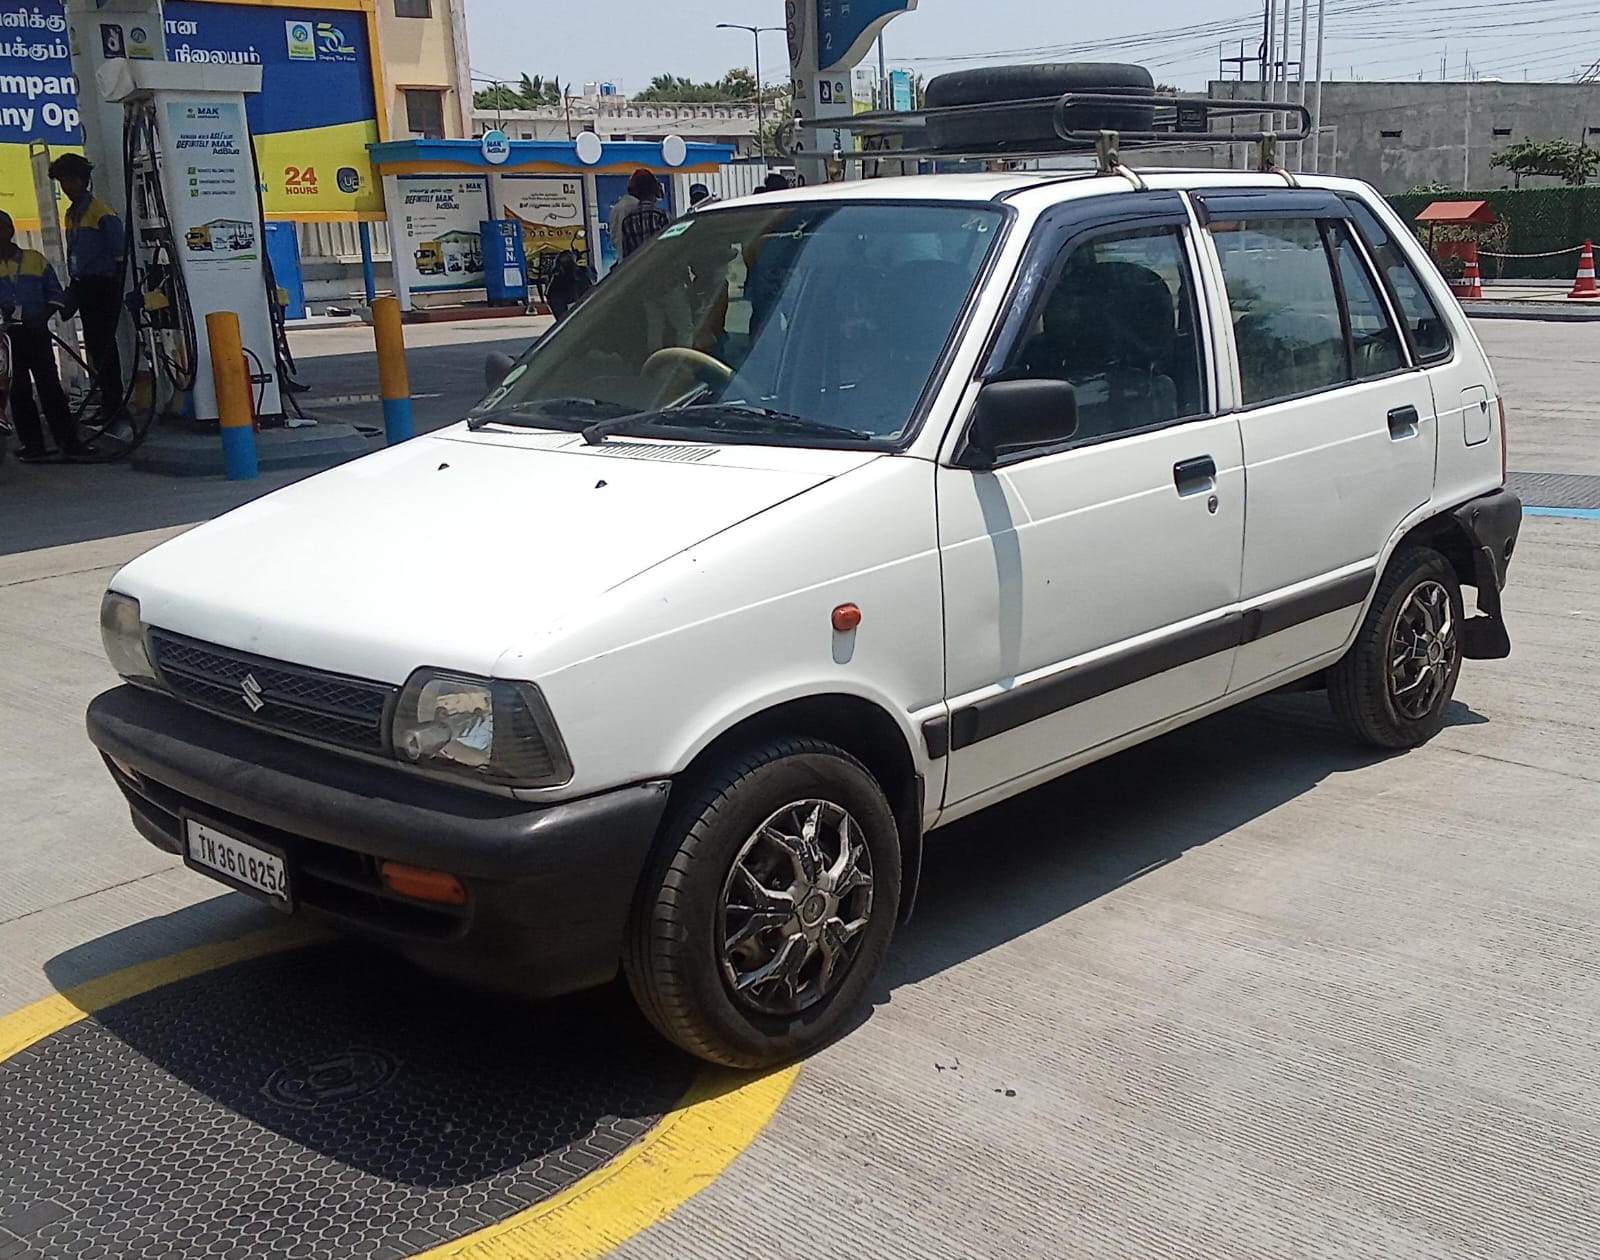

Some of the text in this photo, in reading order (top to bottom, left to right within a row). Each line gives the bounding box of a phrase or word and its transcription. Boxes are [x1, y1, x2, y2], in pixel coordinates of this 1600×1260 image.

[0, 7, 66, 32] னிக்கு
[0, 102, 80, 132] ny Op
[198, 107, 220, 115] MAK
[211, 140, 234, 148] MAK
[284, 167, 318, 186] 24
[286, 187, 318, 195] HOURS
